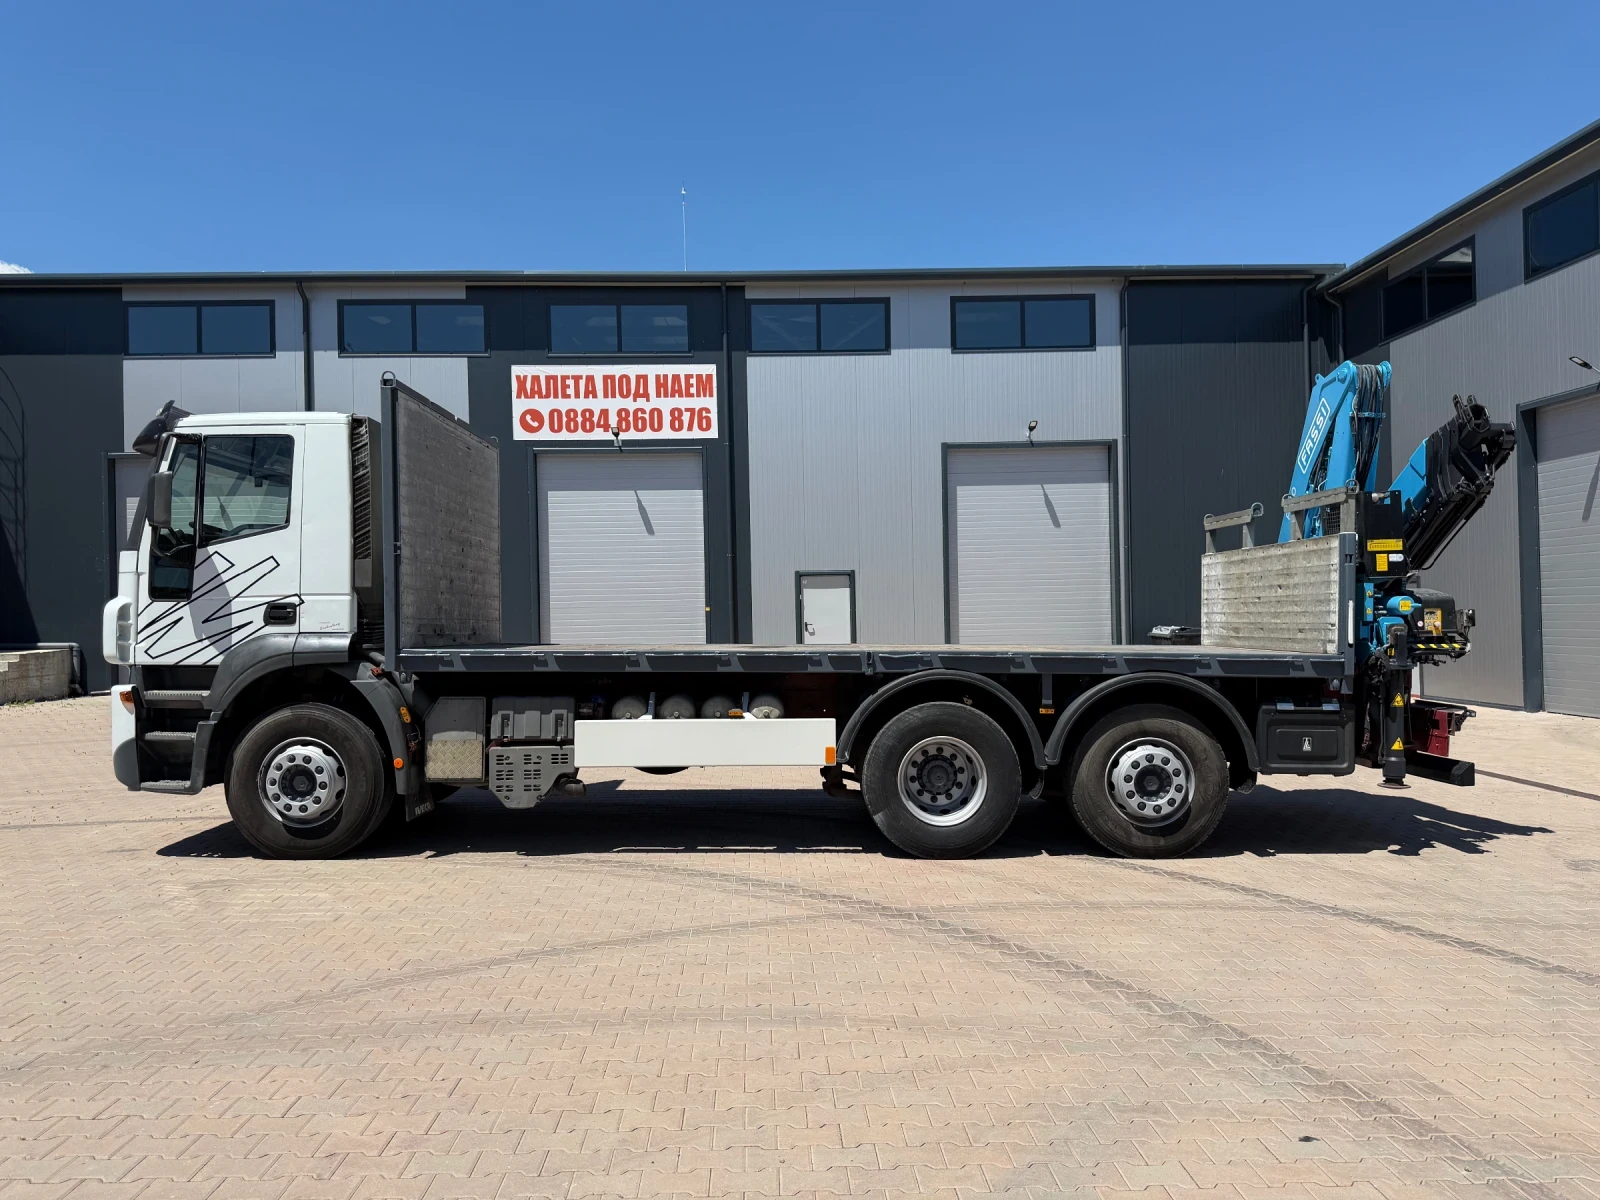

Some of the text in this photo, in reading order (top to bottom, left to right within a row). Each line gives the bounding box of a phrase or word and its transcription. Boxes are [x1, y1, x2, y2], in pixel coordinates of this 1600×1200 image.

[515, 373, 714, 402] ХАЛЕТА ПОД НАЕМ
[548, 406, 712, 434] 0884 860 876
[1301, 406, 1327, 466] FASSI
[414, 801, 431, 816] IVECO
